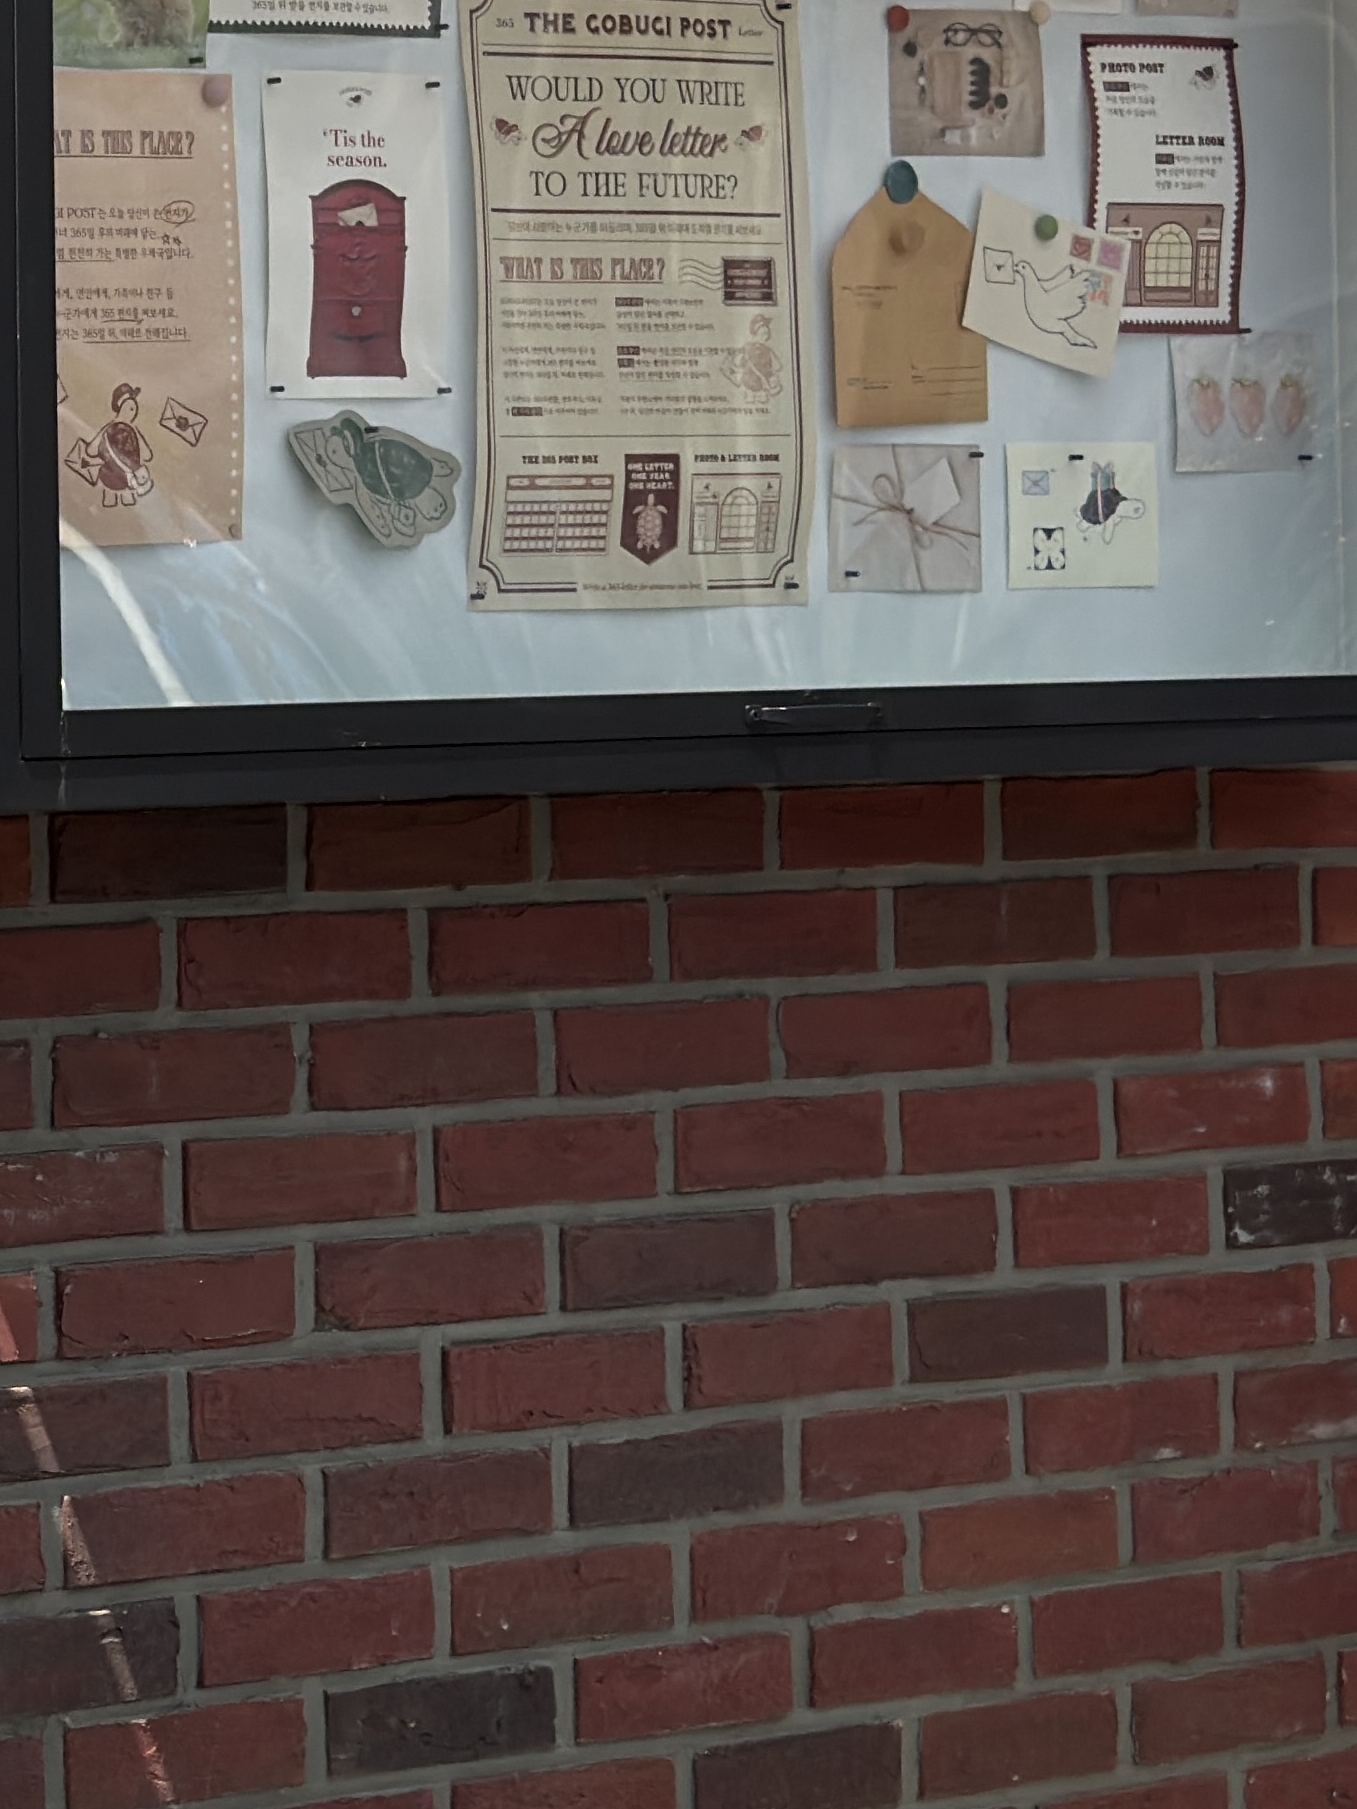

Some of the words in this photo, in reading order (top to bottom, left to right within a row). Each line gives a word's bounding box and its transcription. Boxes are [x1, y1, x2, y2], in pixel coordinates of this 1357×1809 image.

[523, 11, 577, 35] THE
[584, 12, 672, 38] GOBUGI
[679, 17, 732, 40] POST
[1100, 62, 1135, 73] PHOTO
[1139, 62, 1165, 74] POST
[505, 74, 604, 102] WOULD
[613, 76, 667, 104] YOU
[675, 78, 746, 106] WRITE
[80, 129, 95, 154] IS
[101, 130, 133, 155] THIS
[360, 129, 385, 148] the
[531, 106, 602, 160] A
[595, 117, 656, 157] love
[658, 117, 729, 159] letter
[1155, 134, 1195, 146] LETTER
[1198, 136, 1225, 147] ROOM
[327, 153, 387, 168] season.
[529, 170, 568, 197] TO
[576, 171, 627, 198] THE
[638, 172, 739, 200] FUTURE?
[499, 256, 544, 280] WHAT
[549, 257, 564, 280] IS
[569, 257, 604, 280] THIS
[57, 308, 98, 320] 군가에게
